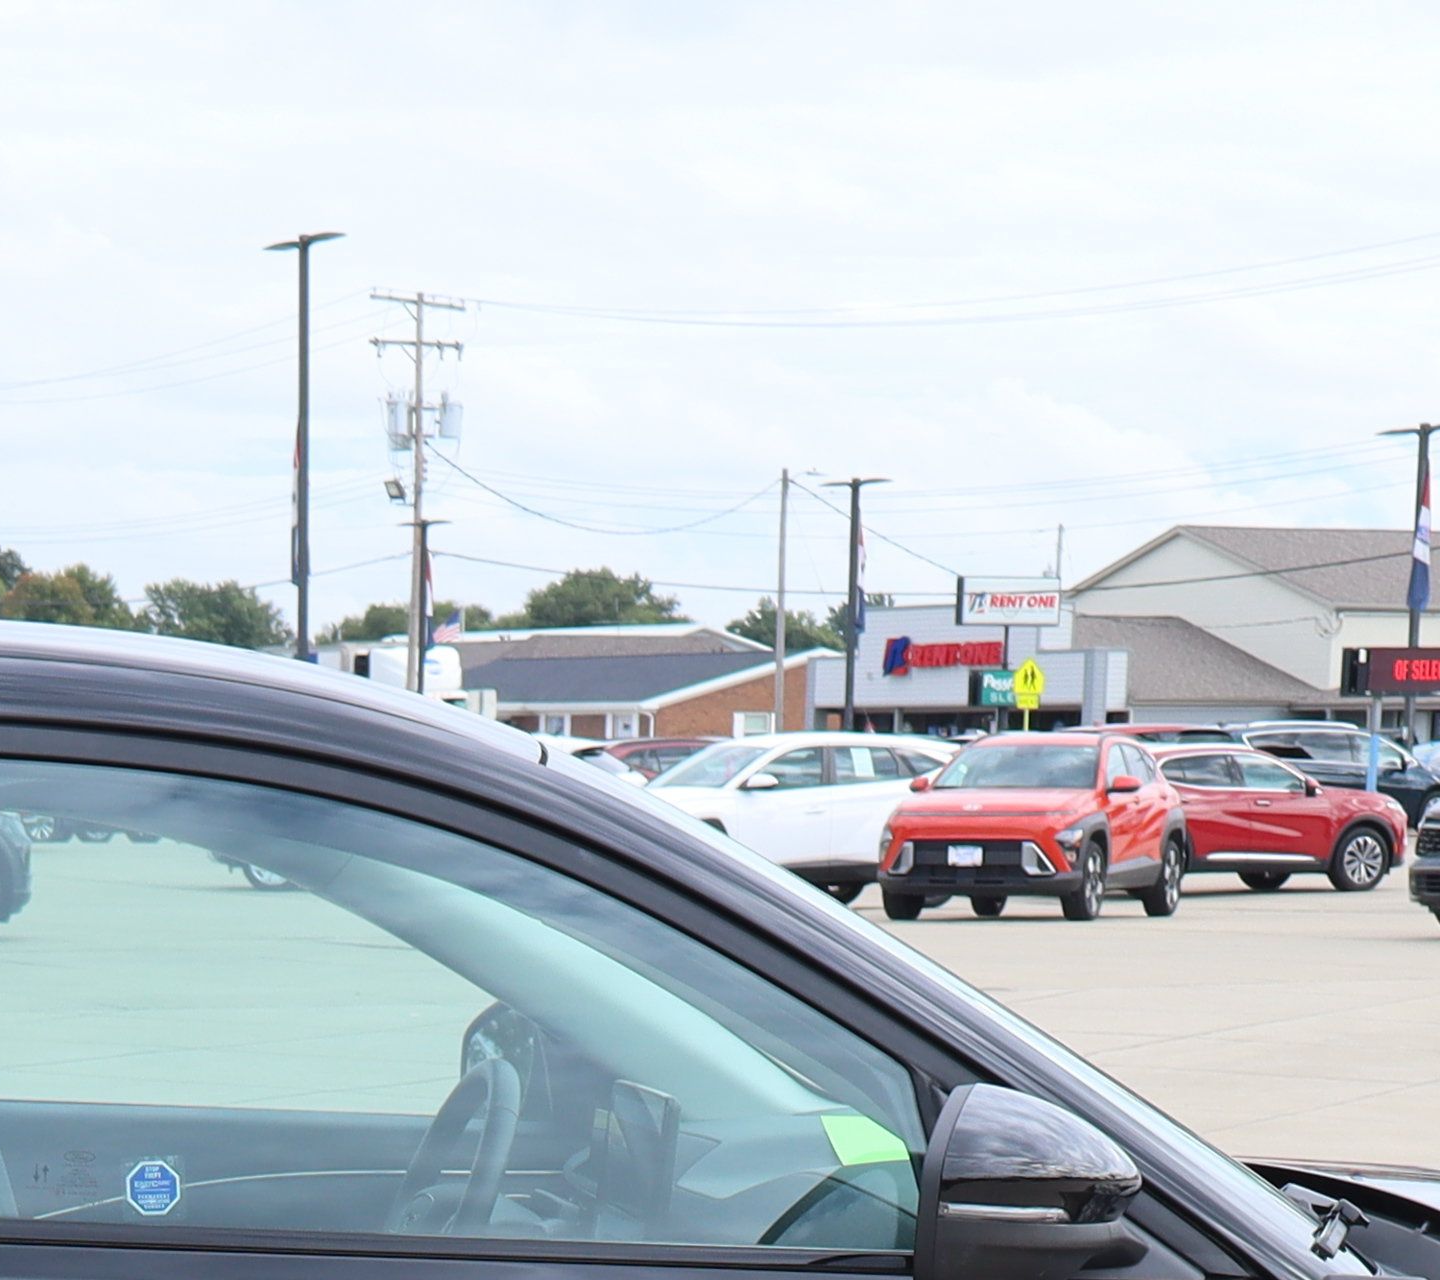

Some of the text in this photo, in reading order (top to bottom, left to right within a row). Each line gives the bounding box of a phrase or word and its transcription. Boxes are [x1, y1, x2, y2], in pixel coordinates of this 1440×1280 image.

[990, 593, 1057, 608] RENT ONE
[910, 641, 1002, 668] RENT ONE
[1394, 660, 1409, 681] OF
